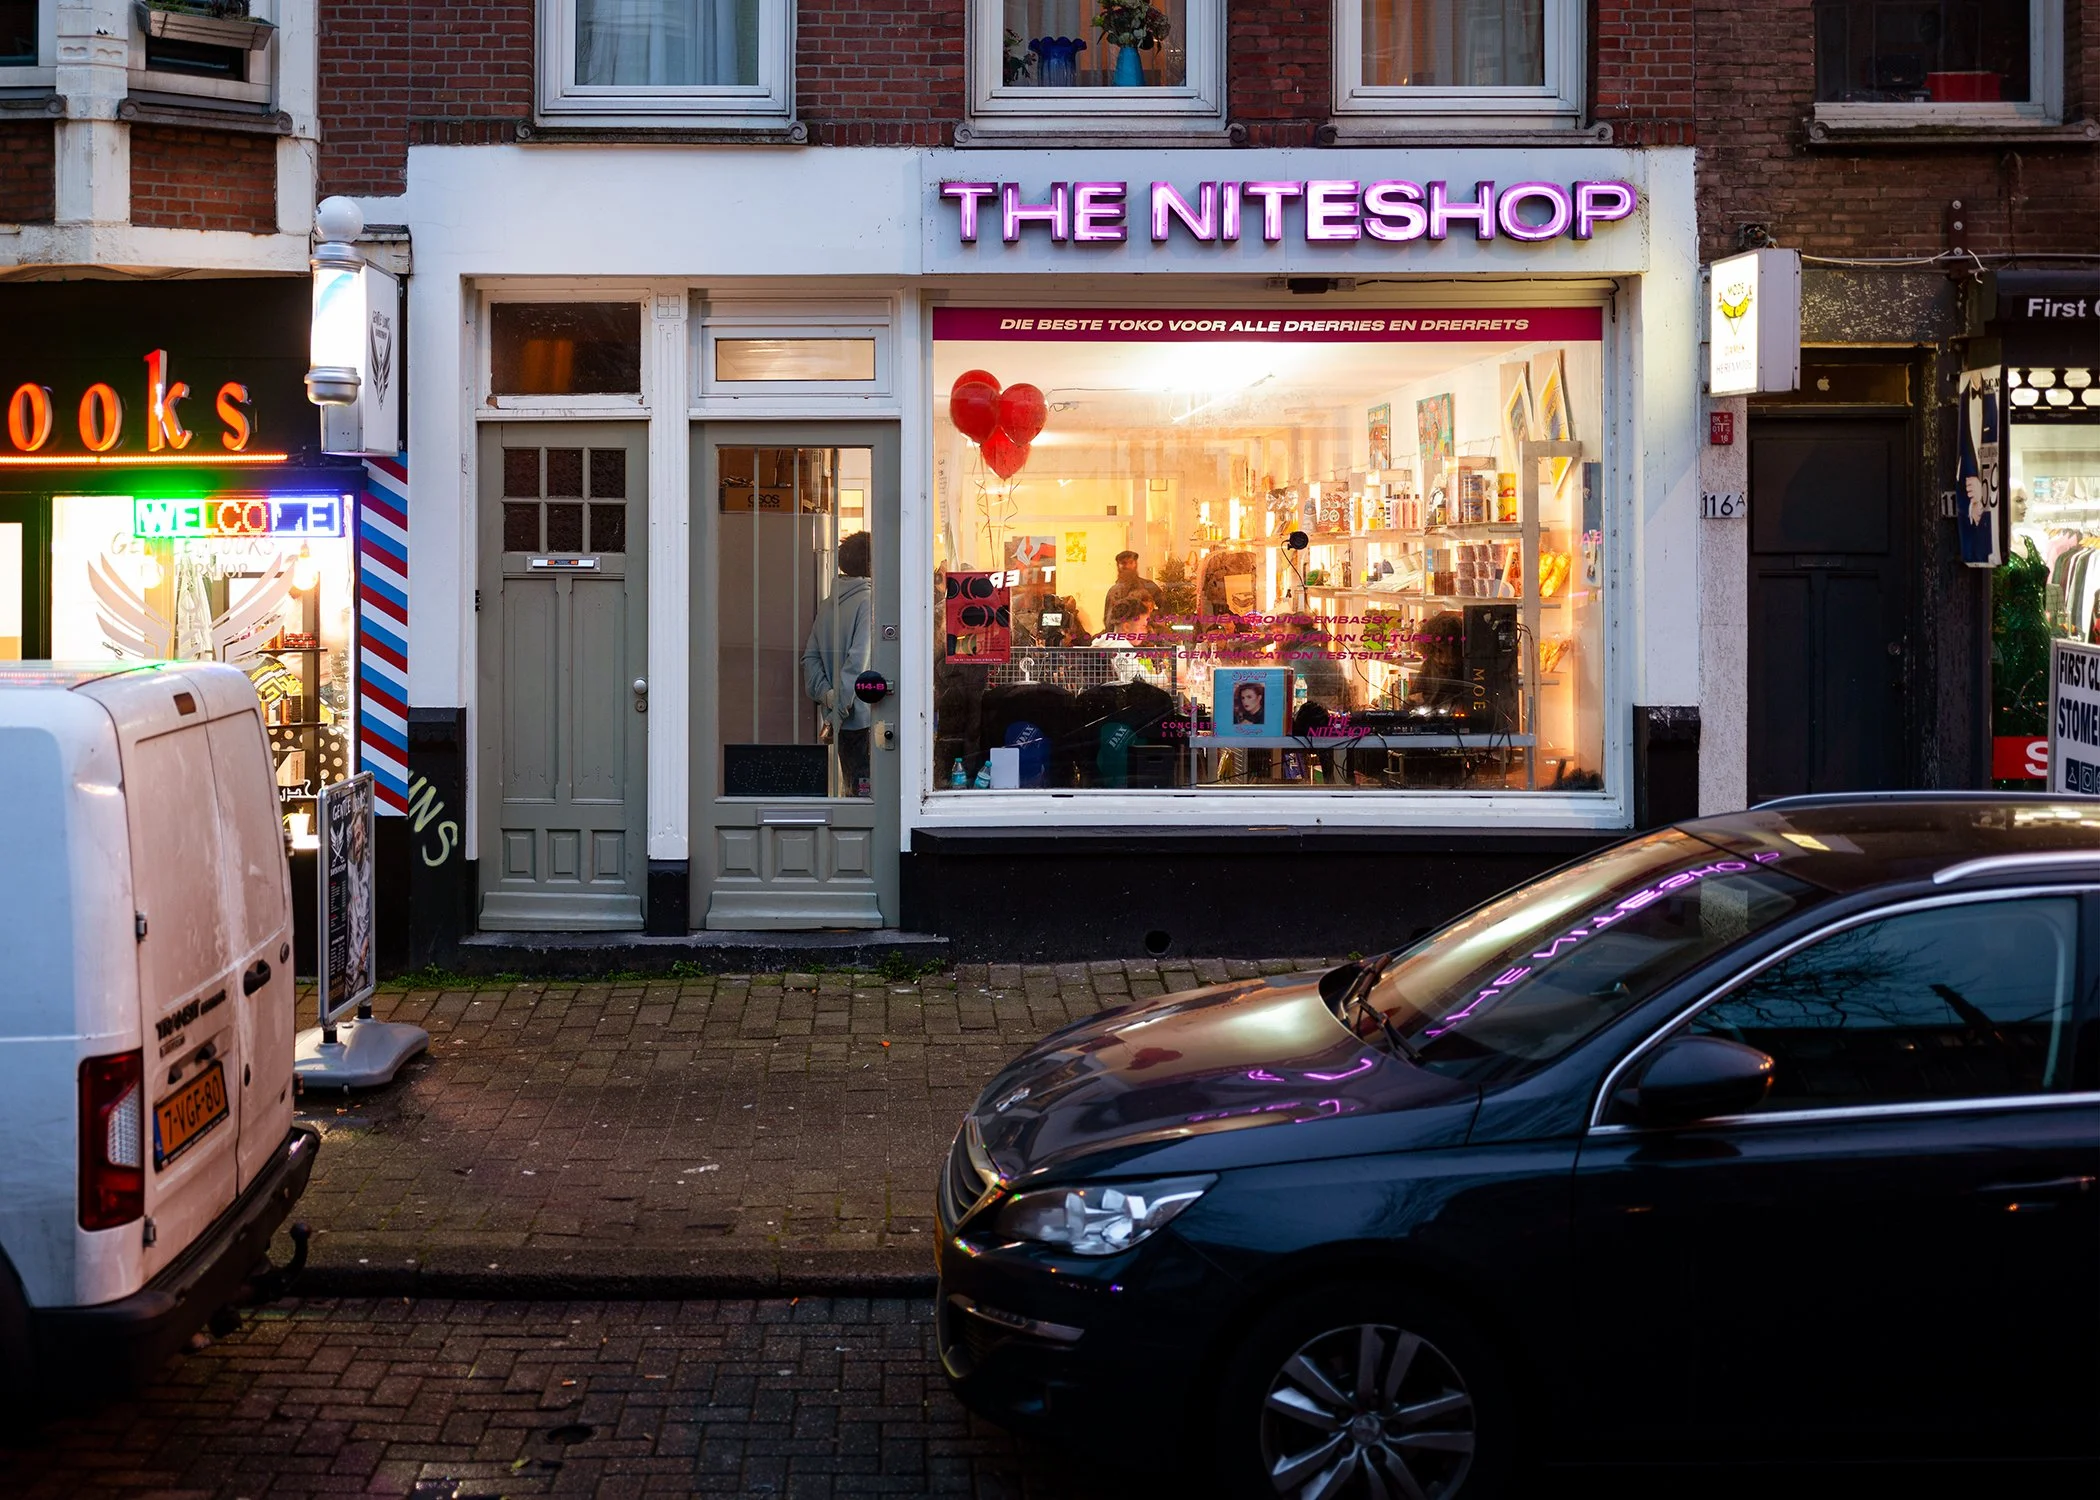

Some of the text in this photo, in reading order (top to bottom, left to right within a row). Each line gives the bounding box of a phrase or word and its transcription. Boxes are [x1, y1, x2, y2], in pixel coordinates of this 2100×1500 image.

[938, 178, 1638, 243] THE NITESHOP
[2027, 297, 2087, 319] First
[1000, 319, 1529, 332] DIE BESTE TOKO VOOR ALLE DRERRIES EN DRERRETS
[8, 349, 253, 452] ooks
[1703, 493, 1746, 516] 116A
[1313, 615, 1395, 625] EMBASSY
[1105, 632, 1433, 643] RESEARCH CENTRE FOR URBAN CULTURE
[1317, 651, 1395, 661] TESTSITE
[2059, 651, 2086, 689] FIRST
[1161, 721, 1218, 729] CONCRETE
[1327, 715, 1352, 727] THE
[1306, 726, 1372, 738] NITESHOP
[164, 1074, 221, 1145] 7-VGF-80
